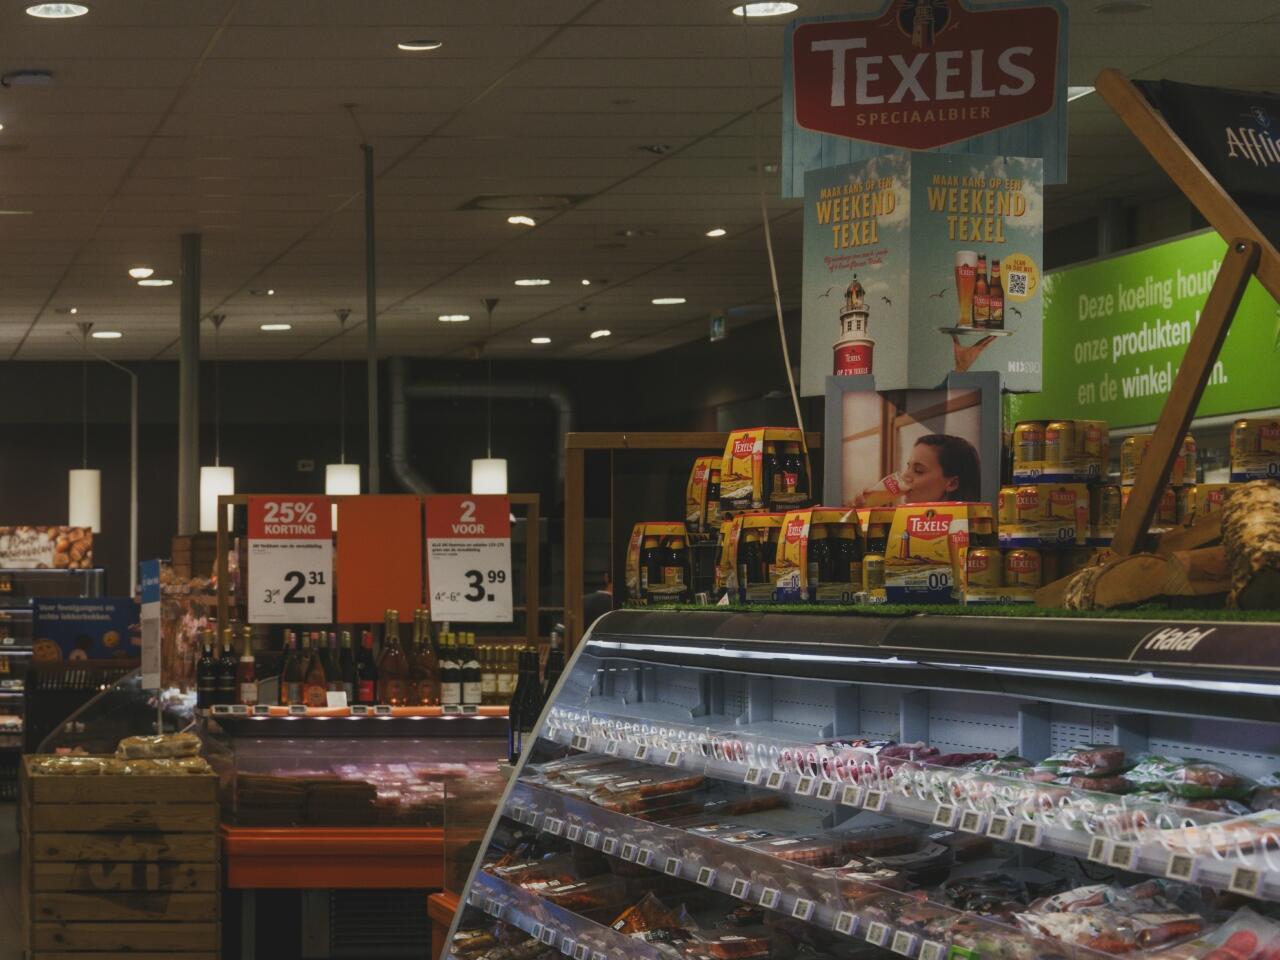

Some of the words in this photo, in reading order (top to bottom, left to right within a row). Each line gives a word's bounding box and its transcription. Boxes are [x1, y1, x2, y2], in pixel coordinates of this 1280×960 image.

[811, 38, 1036, 107] TEXELS
[856, 106, 991, 126] SPECIAALBIER
[816, 189, 896, 225] WEEKEND
[927, 186, 1026, 217] WEEKEND
[832, 220, 879, 249] TEXEL
[946, 215, 1008, 243] TEXEL
[1078, 293, 1114, 321] Deze
[1118, 275, 1173, 313] koeling
[1074, 337, 1108, 364] onze
[1112, 317, 1191, 364] produkten
[1077, 383, 1095, 405] en
[1099, 373, 1118, 402] de
[1122, 362, 1172, 399] winkel
[734, 440, 754, 454] TEXELS
[263, 502, 317, 523] 25%
[459, 500, 476, 522] 2
[910, 517, 949, 532] TEXELS
[264, 523, 316, 535] KORTING
[451, 523, 485, 535] VOOR
[283, 570, 326, 604] 2.31
[464, 569, 506, 602] 3.99
[1144, 627, 1217, 651] Halal
